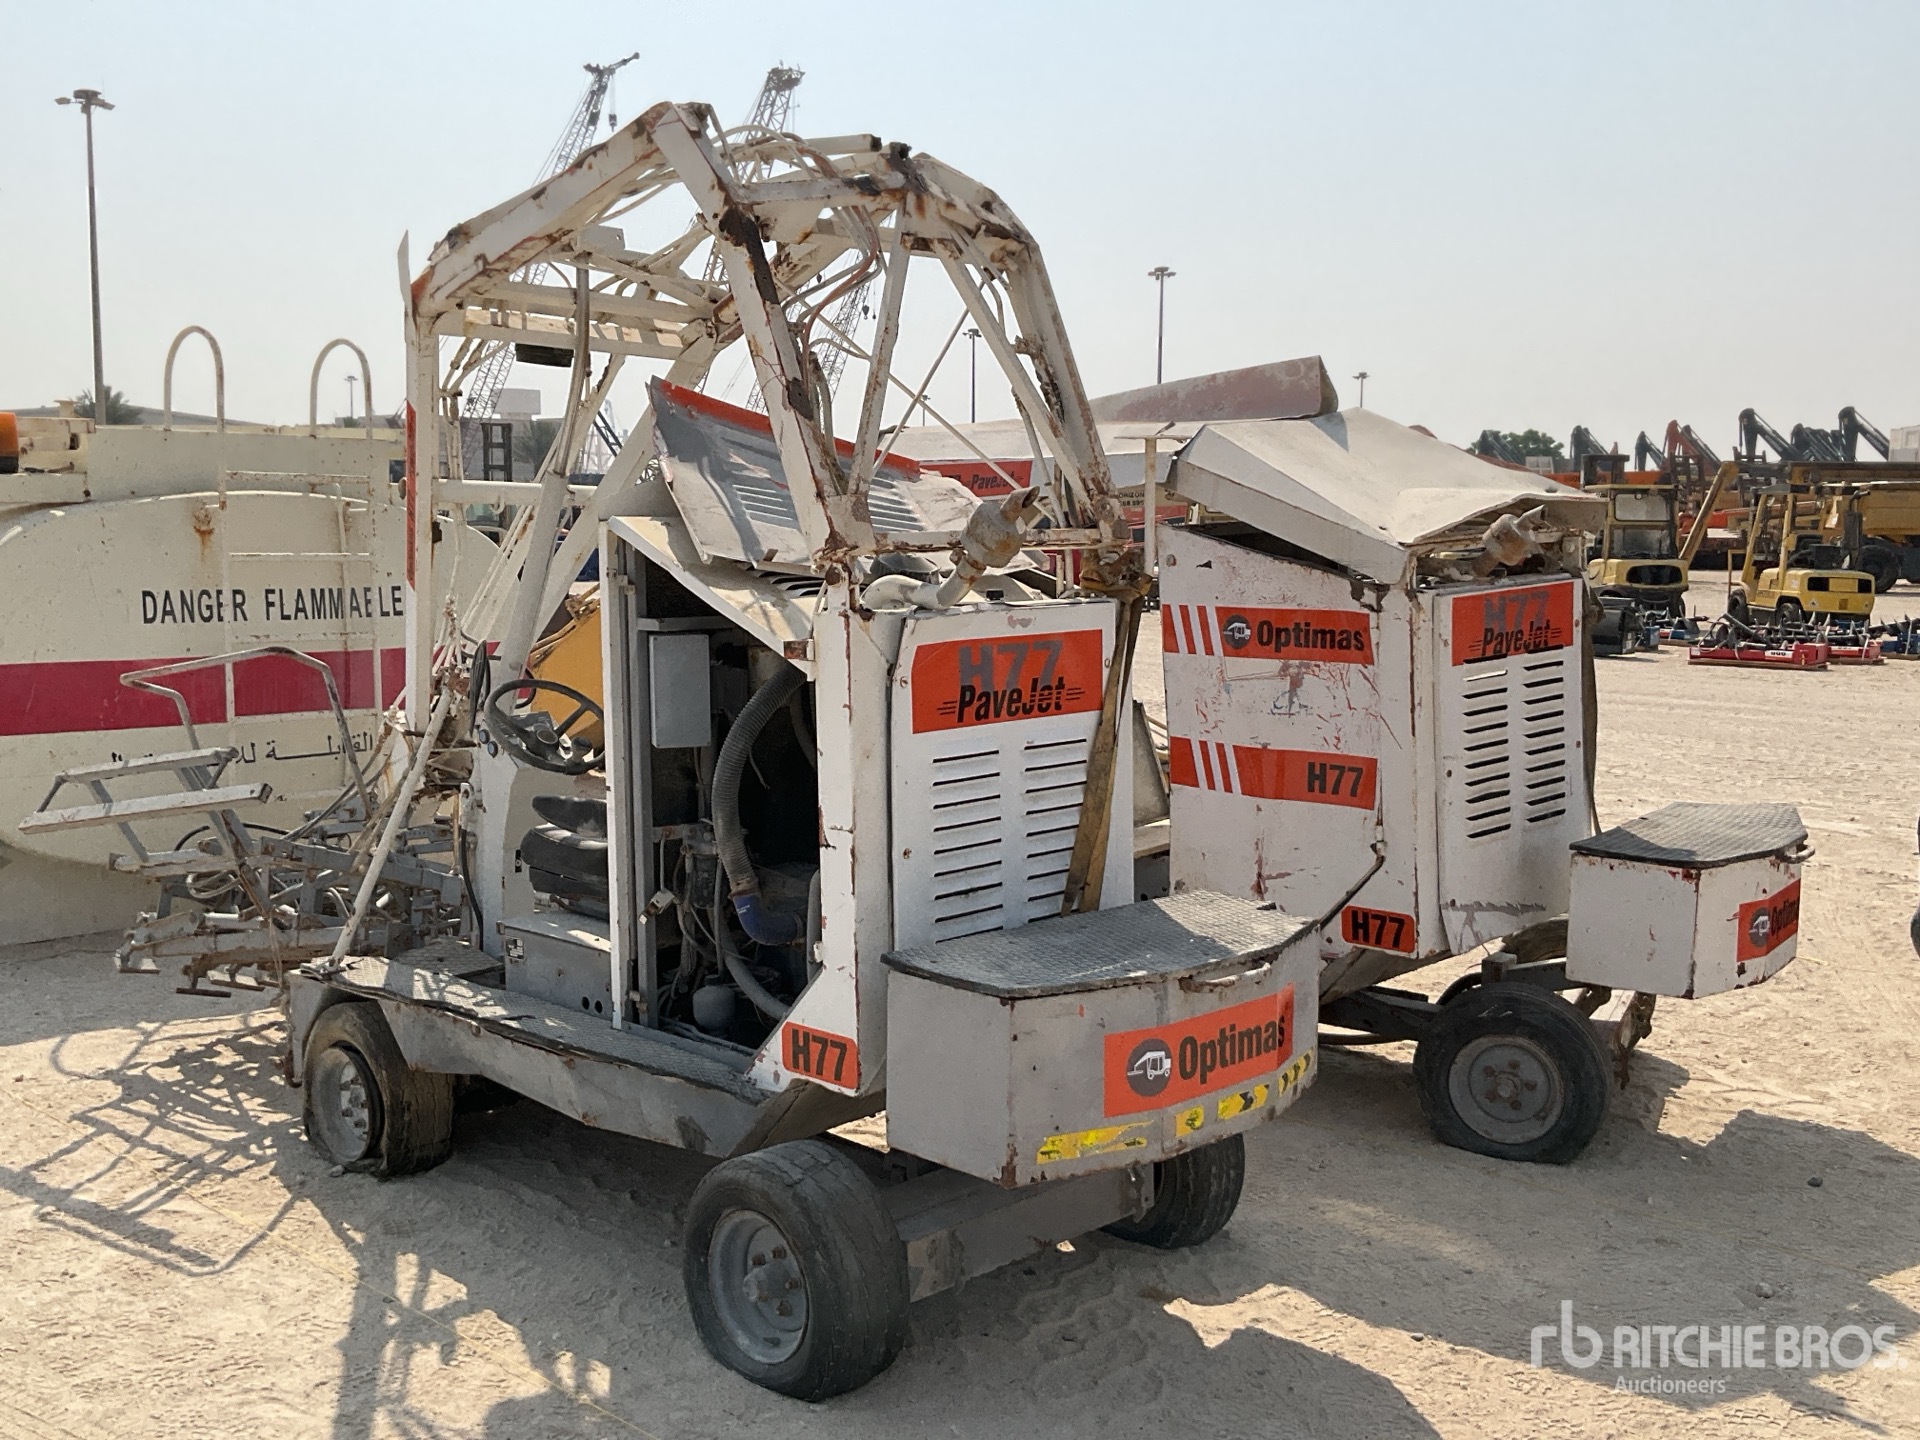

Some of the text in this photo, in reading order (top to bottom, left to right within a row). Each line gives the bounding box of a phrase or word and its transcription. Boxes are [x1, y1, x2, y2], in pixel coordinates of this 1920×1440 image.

[1118, 491, 1145, 499] ORIZON
[141, 589, 248, 624] DANGER
[1484, 590, 1550, 630] H77
[1257, 620, 1365, 653] Optimas
[1481, 619, 1551, 656] PaveJet
[958, 639, 1064, 691] H77
[956, 676, 1066, 723] PaveJet
[1307, 762, 1365, 797] H77
[1351, 910, 1405, 949] H77
[790, 1029, 848, 1082] H77
[1178, 1014, 1286, 1084] Optimas
